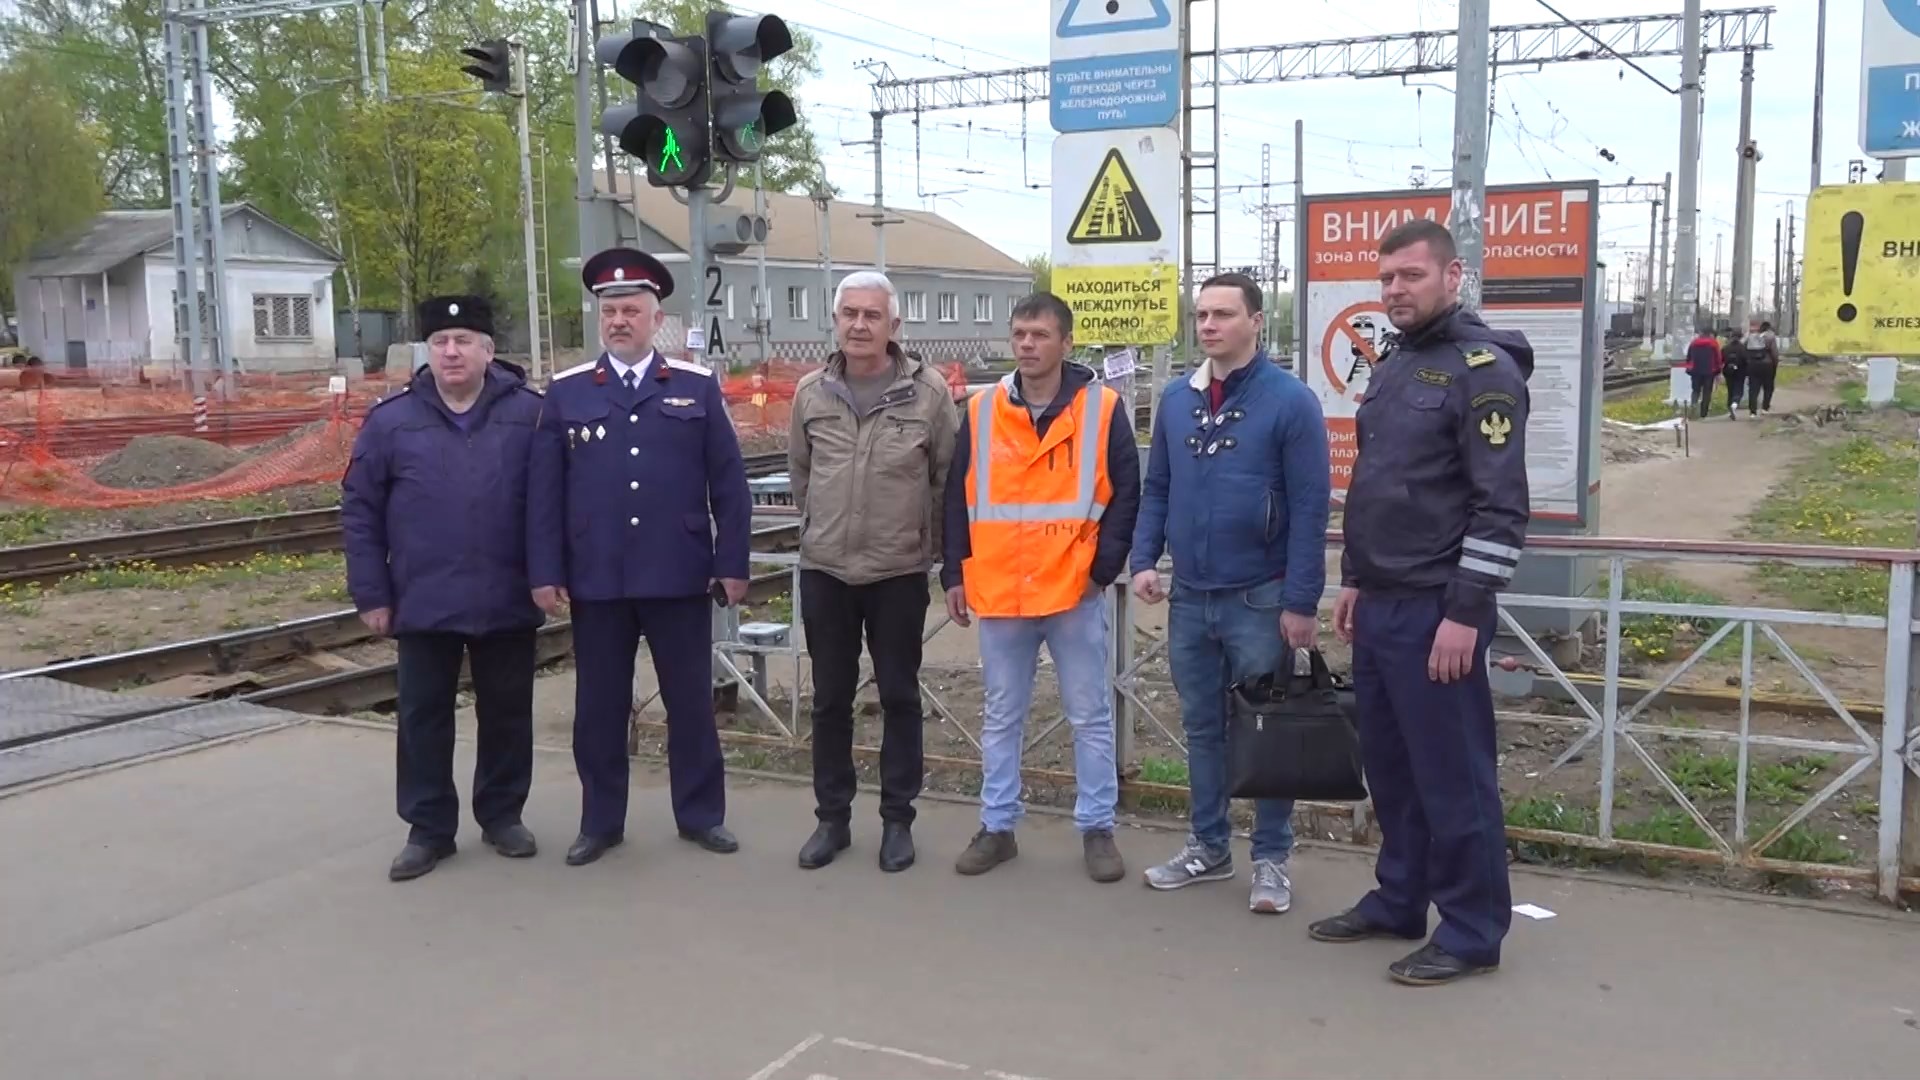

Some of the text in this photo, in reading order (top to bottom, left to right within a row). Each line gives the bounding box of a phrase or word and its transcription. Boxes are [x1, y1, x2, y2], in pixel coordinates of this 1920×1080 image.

[1056, 63, 1172, 82] БУДЬТЕ ВНИМАТЕЛЬНЫ
[1069, 79, 1156, 95] ПЕРЕХОДЯ ЧЕРЕЗ
[1060, 91, 1167, 109] ЖЕЛЕЗНОДОРОЖНЫЙ
[1097, 109, 1127, 120] ПУТЬ!
[1315, 250, 1353, 264] зона
[1358, 250, 1379, 263] по
[1883, 240, 1920, 258] ВН
[706, 265, 723, 306] 2
[1066, 279, 1161, 294] НАХОДИТЬСЯ
[1073, 297, 1168, 312] МЕЖДУПУТЬЕ
[1081, 316, 1145, 330] ОПАСНО!
[708, 315, 725, 355] А
[1044, 522, 1075, 536] ПЧ
[1185, 858, 1206, 876] N
